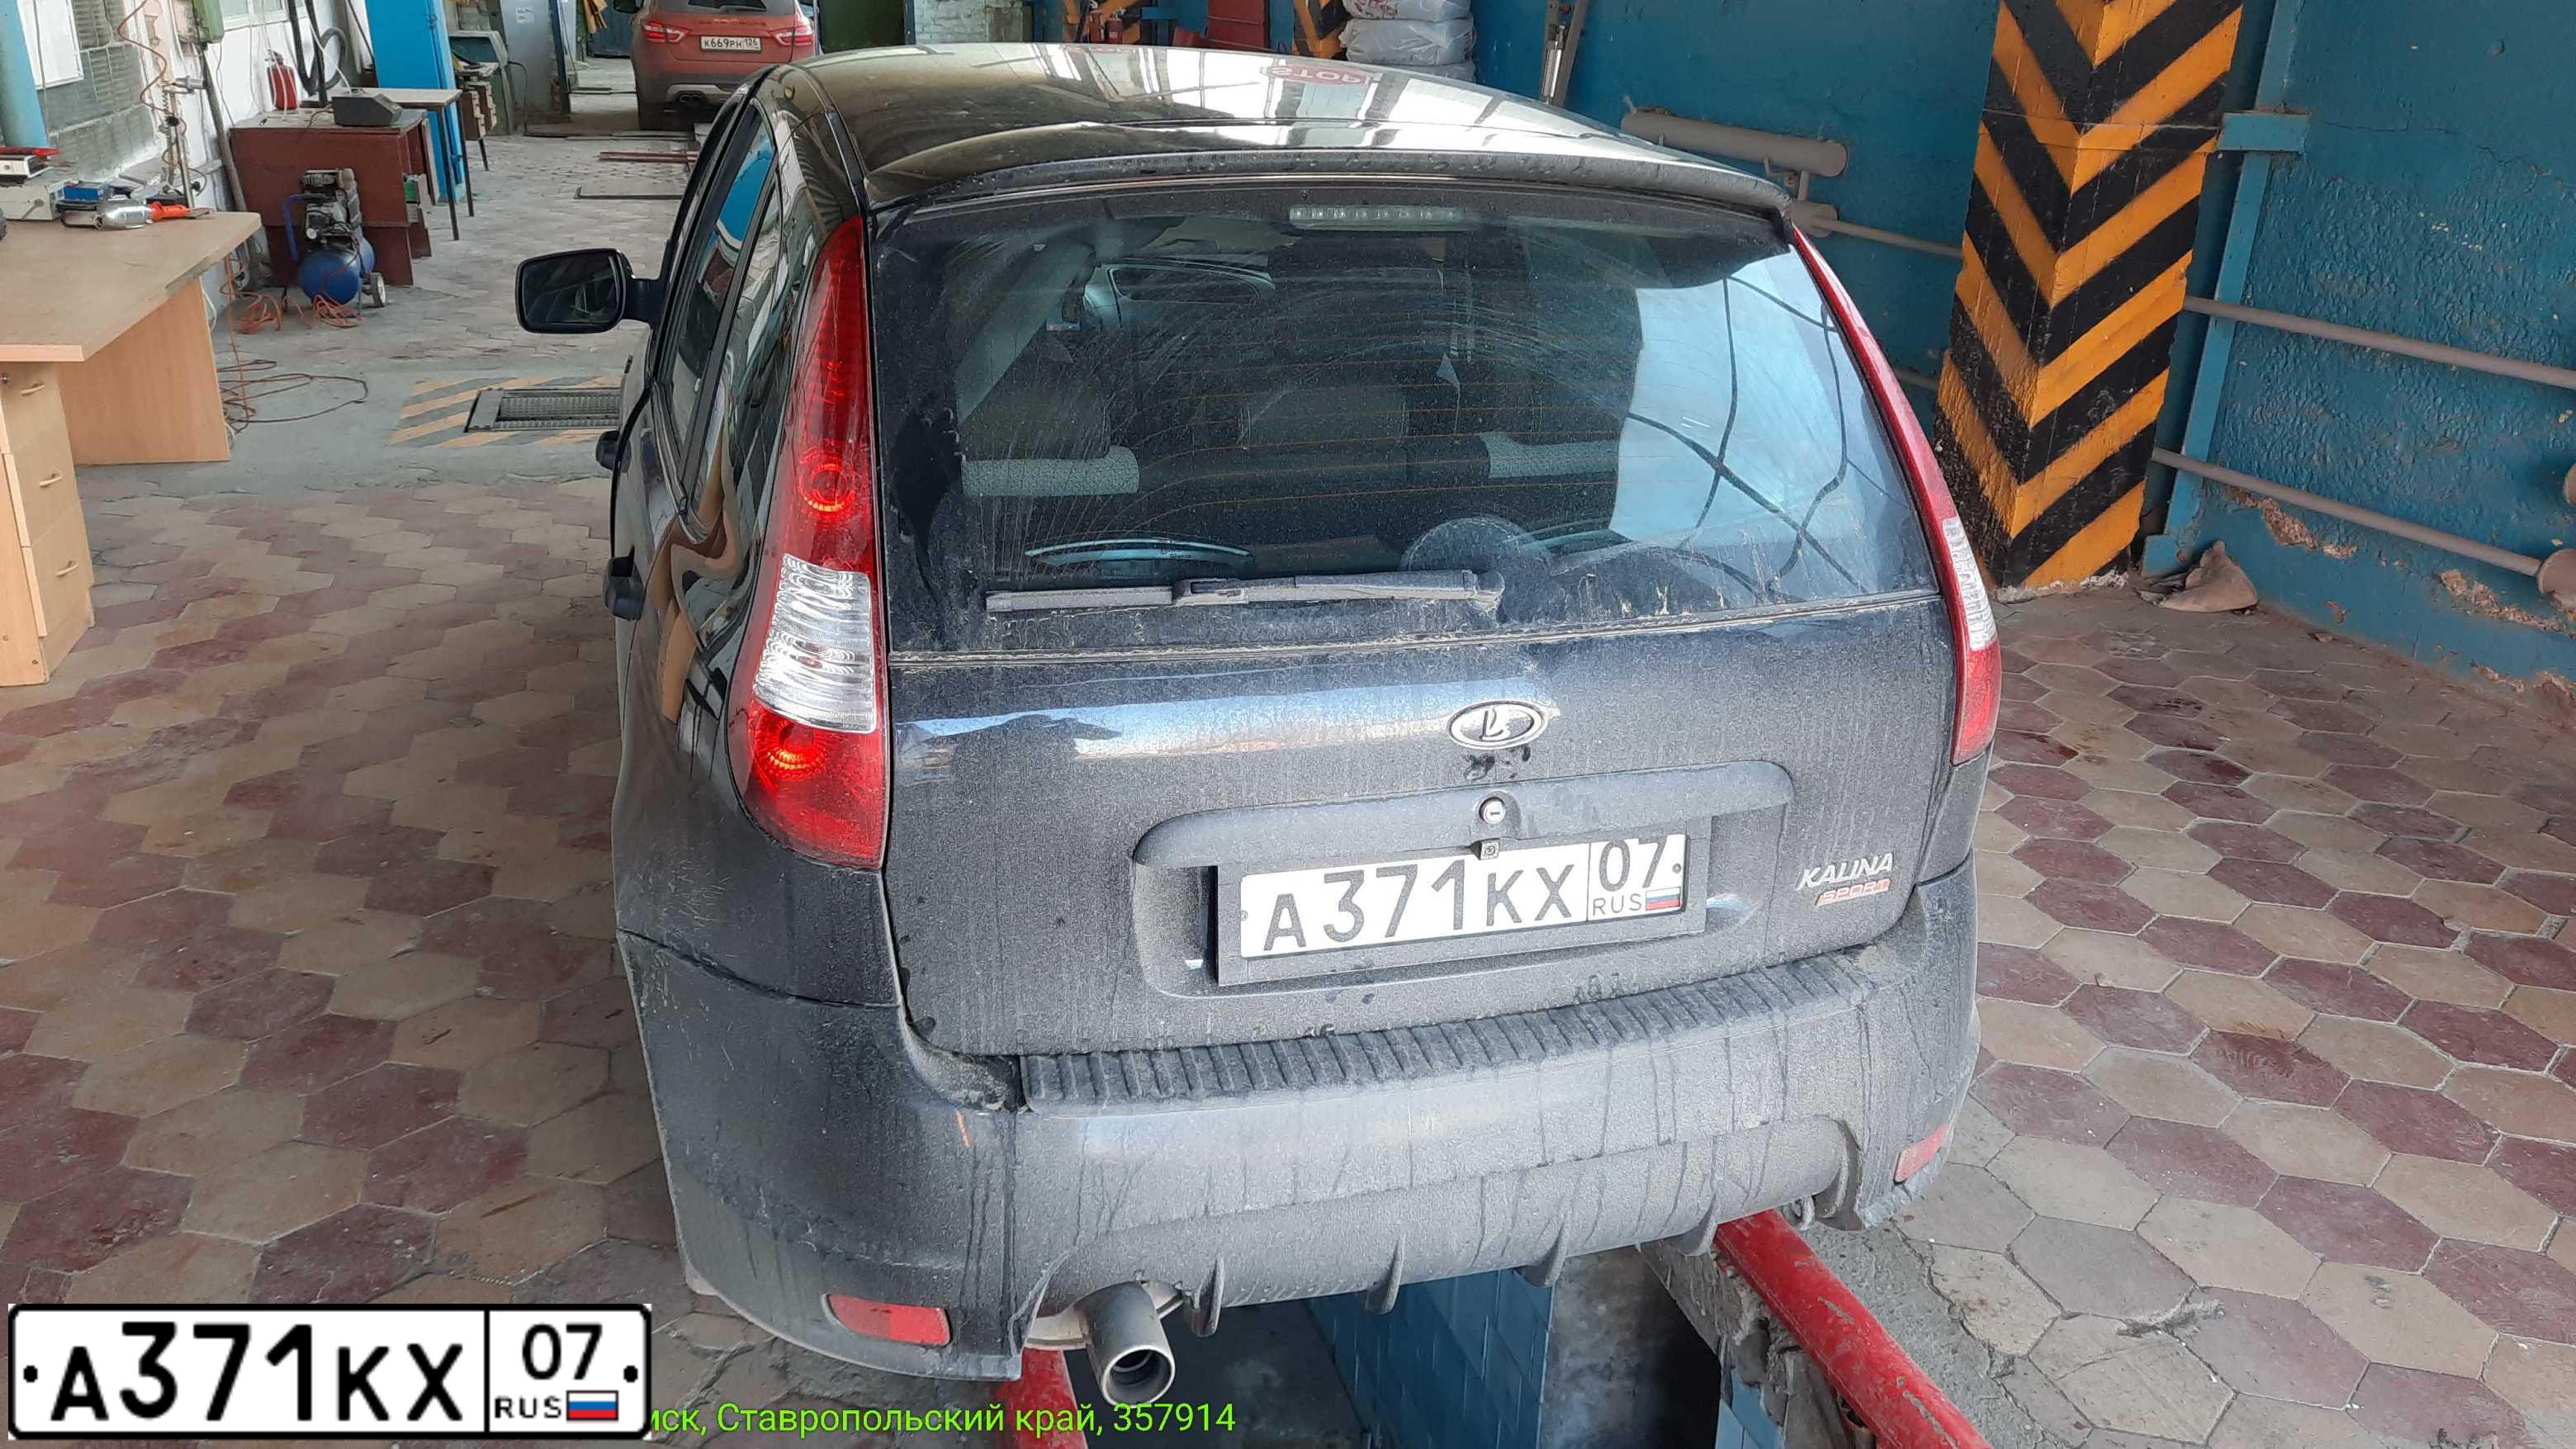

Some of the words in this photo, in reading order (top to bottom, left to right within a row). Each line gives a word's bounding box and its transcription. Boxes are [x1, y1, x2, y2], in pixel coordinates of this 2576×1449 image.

[1795, 852, 1893, 891] KALINA
[1263, 859, 1575, 951] А371КХ
[1599, 836, 1667, 892] 07
[1593, 893, 1642, 916] RUS
